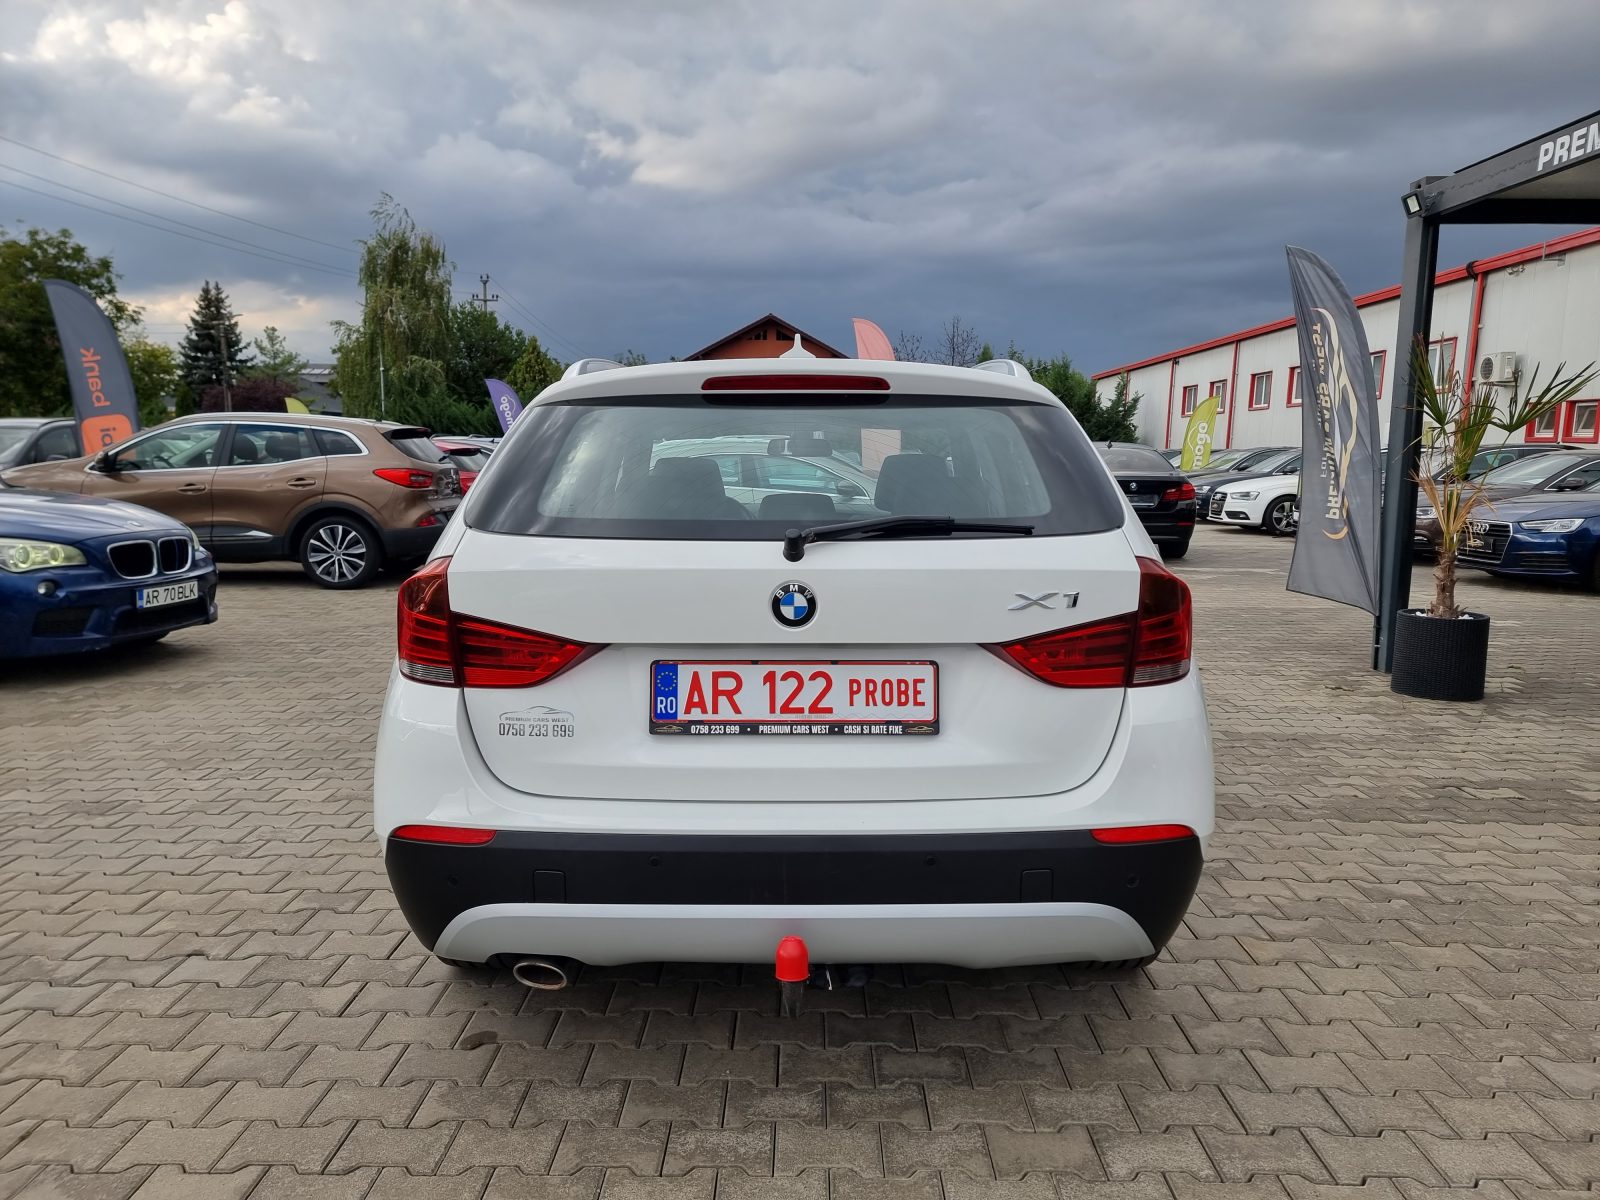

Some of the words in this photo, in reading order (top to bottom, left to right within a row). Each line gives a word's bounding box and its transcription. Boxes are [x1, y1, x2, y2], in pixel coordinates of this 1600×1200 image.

[145, 589, 160, 606] AR
[163, 587, 176, 603] 70
[177, 583, 196, 600] BLK
[776, 584, 814, 599] BMW
[1007, 591, 1080, 611] X1
[683, 670, 743, 715] AR
[762, 670, 834, 715] 122
[848, 678, 926, 707] PROBE
[656, 696, 676, 714] RO
[498, 722, 526, 737] 0758
[528, 723, 549, 737] 233
[552, 724, 575, 738] 699
[690, 725, 709, 734] 0758
[710, 725, 725, 734] 233
[725, 725, 740, 734] 699
[758, 725, 791, 734] PREMIUM
[792, 725, 810, 734] CARS
[811, 725, 830, 734] WEST
[843, 725, 862, 734] CASH
[862, 725, 870, 734] SI
[871, 725, 888, 734] RATE
[888, 725, 903, 735] FIXE
